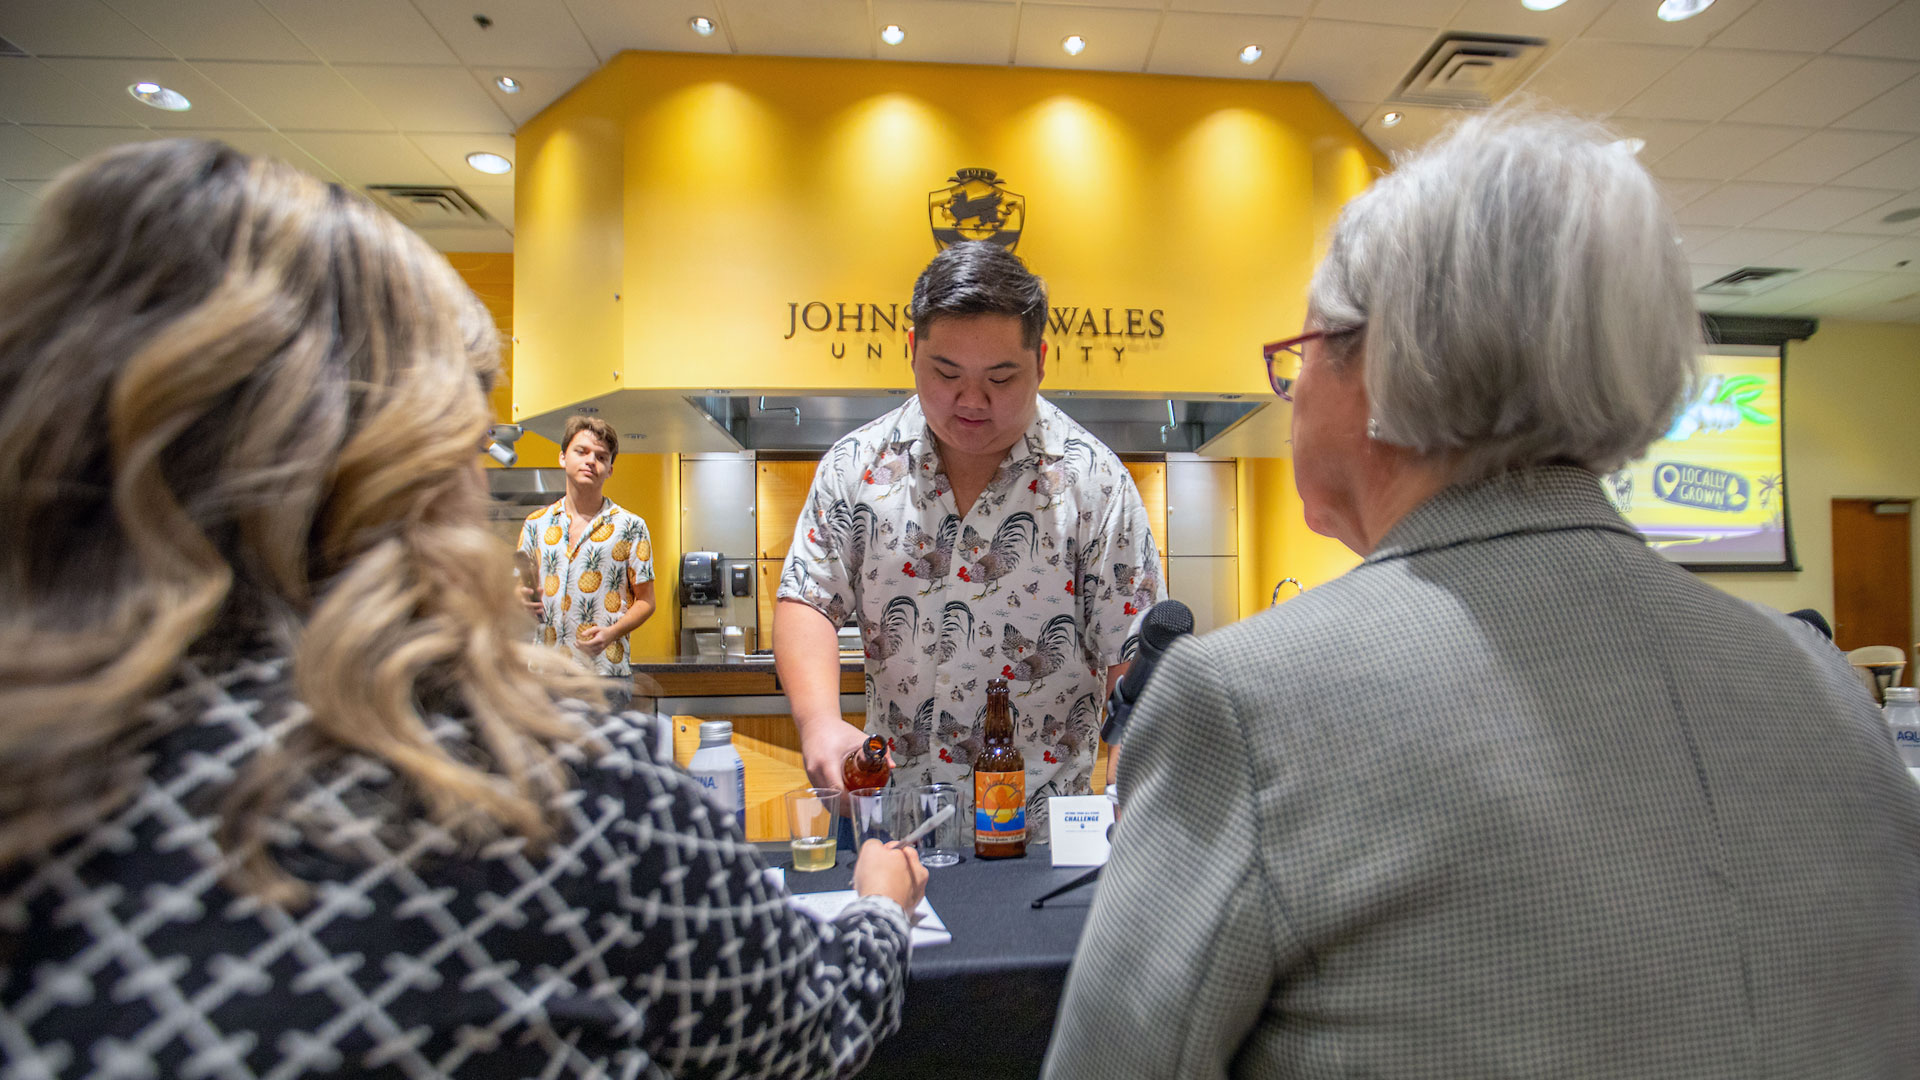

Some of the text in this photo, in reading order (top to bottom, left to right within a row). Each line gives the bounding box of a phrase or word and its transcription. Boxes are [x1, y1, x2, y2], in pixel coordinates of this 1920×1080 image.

[1048, 306, 1165, 338] WALES
[1682, 467, 1728, 489] LOCALLY
[1680, 484, 1725, 505] GROWN
